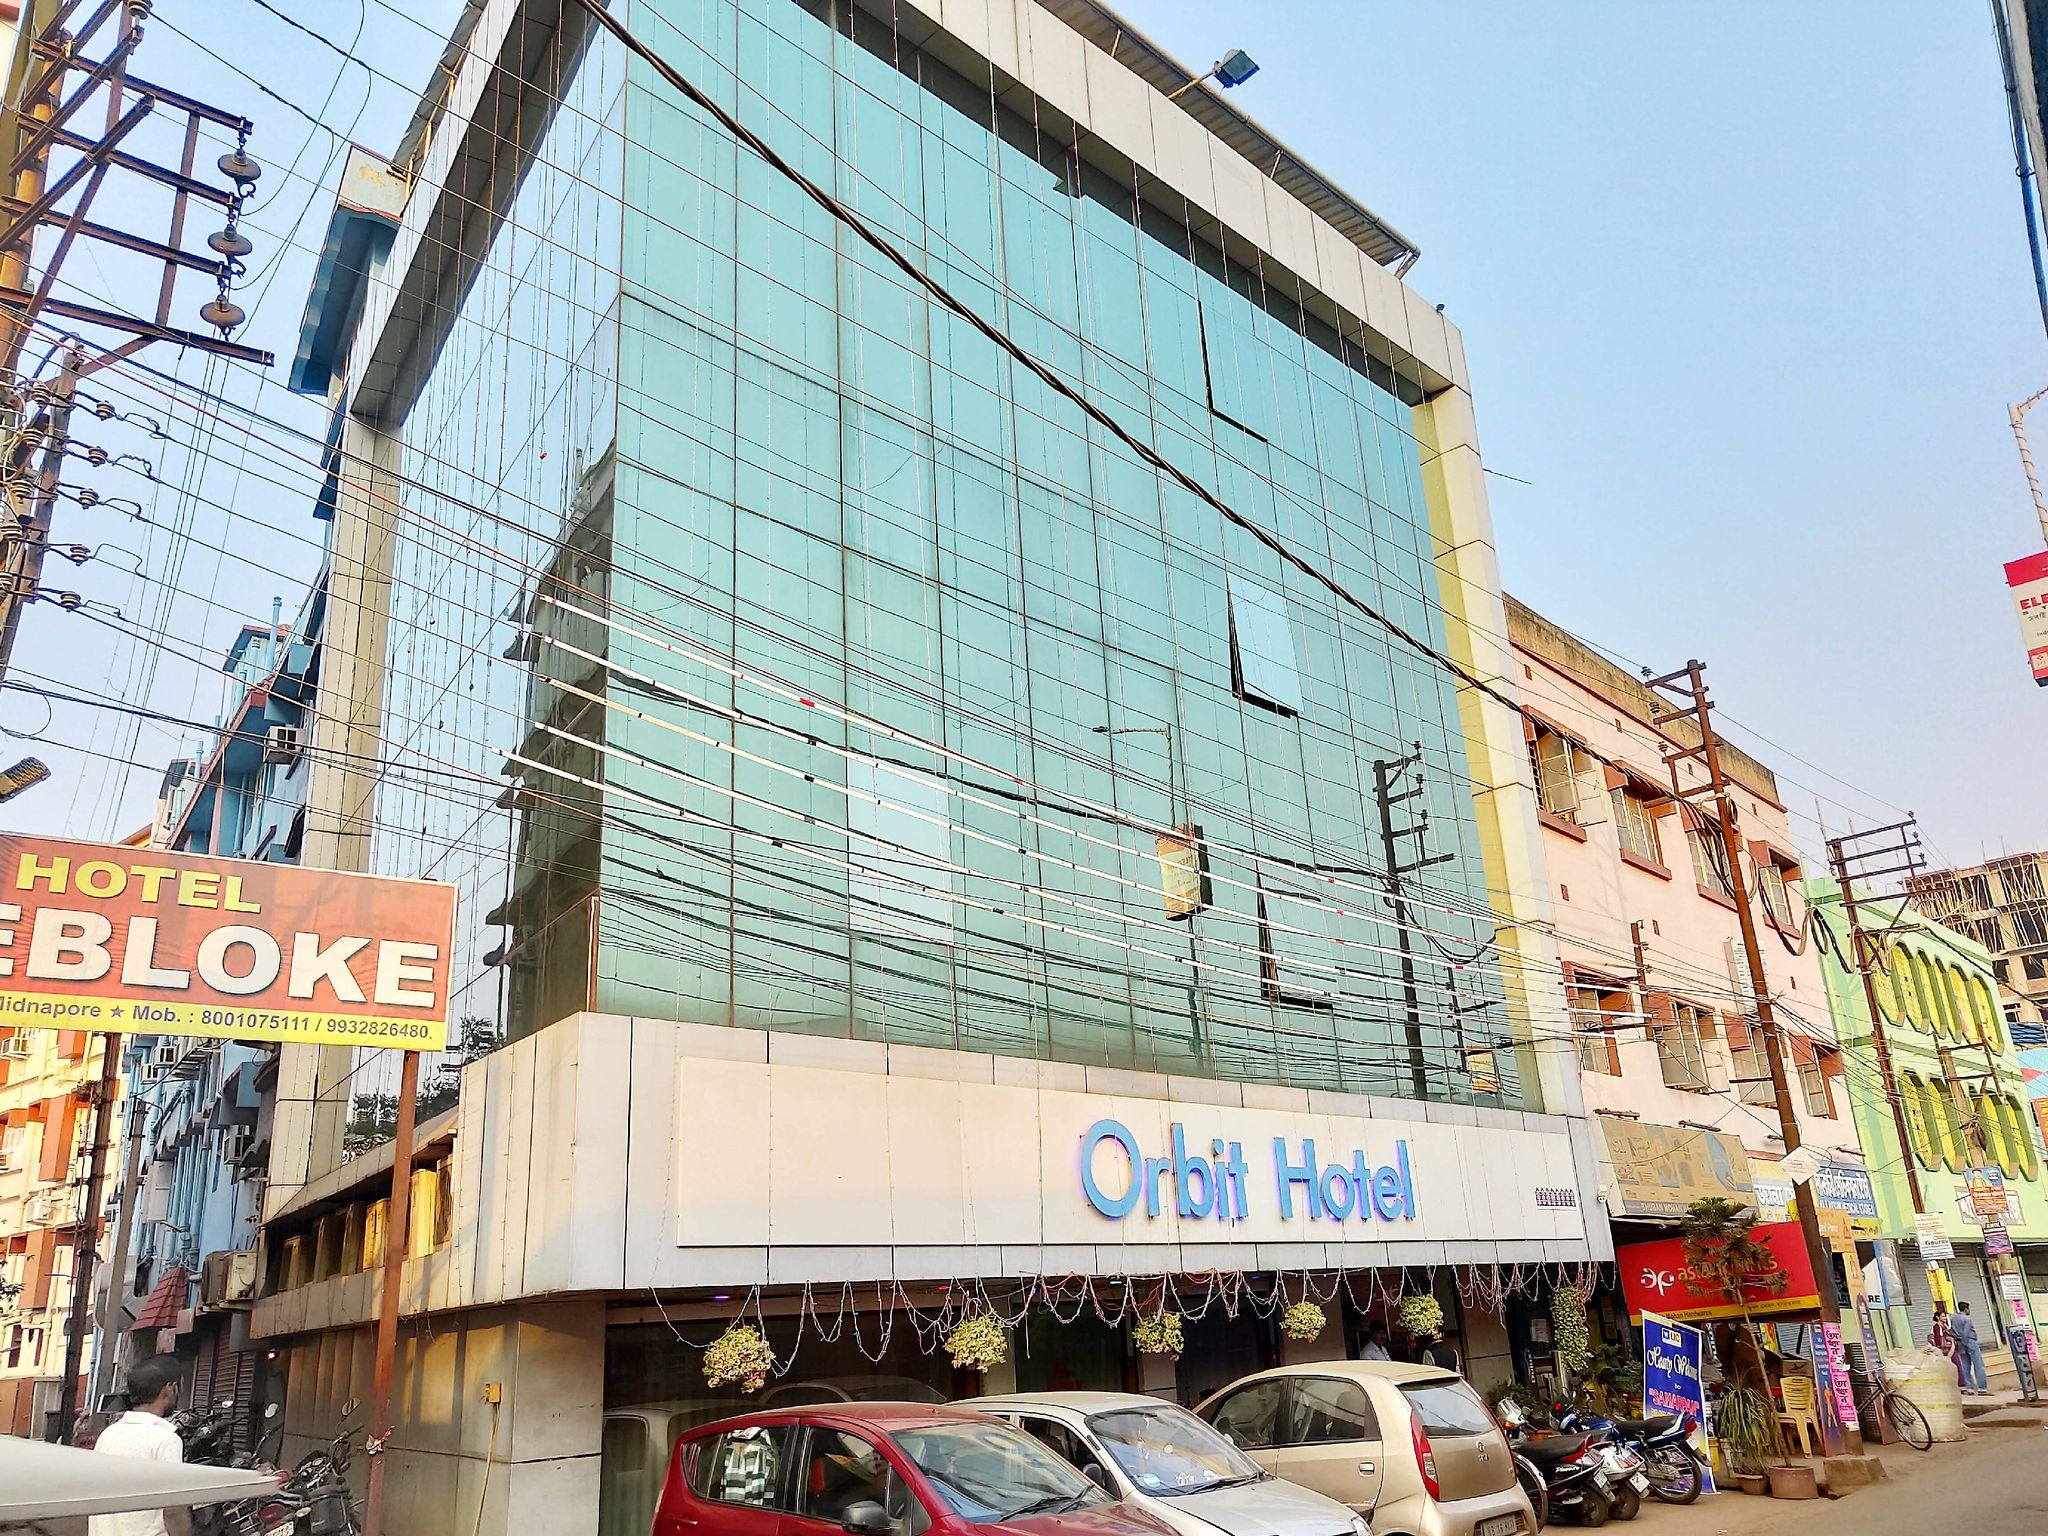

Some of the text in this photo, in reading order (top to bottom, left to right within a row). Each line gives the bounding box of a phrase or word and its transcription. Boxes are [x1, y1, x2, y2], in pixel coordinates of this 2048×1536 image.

[15, 852, 262, 914] HOTEL
[0, 996, 102, 1018] idnapore
[132, 1004, 182, 1023] Mob.
[201, 1010, 309, 1032] 8001075111
[327, 1018, 433, 1040] 9932826480.
[1080, 1118, 1415, 1221] Orbit Hotel
